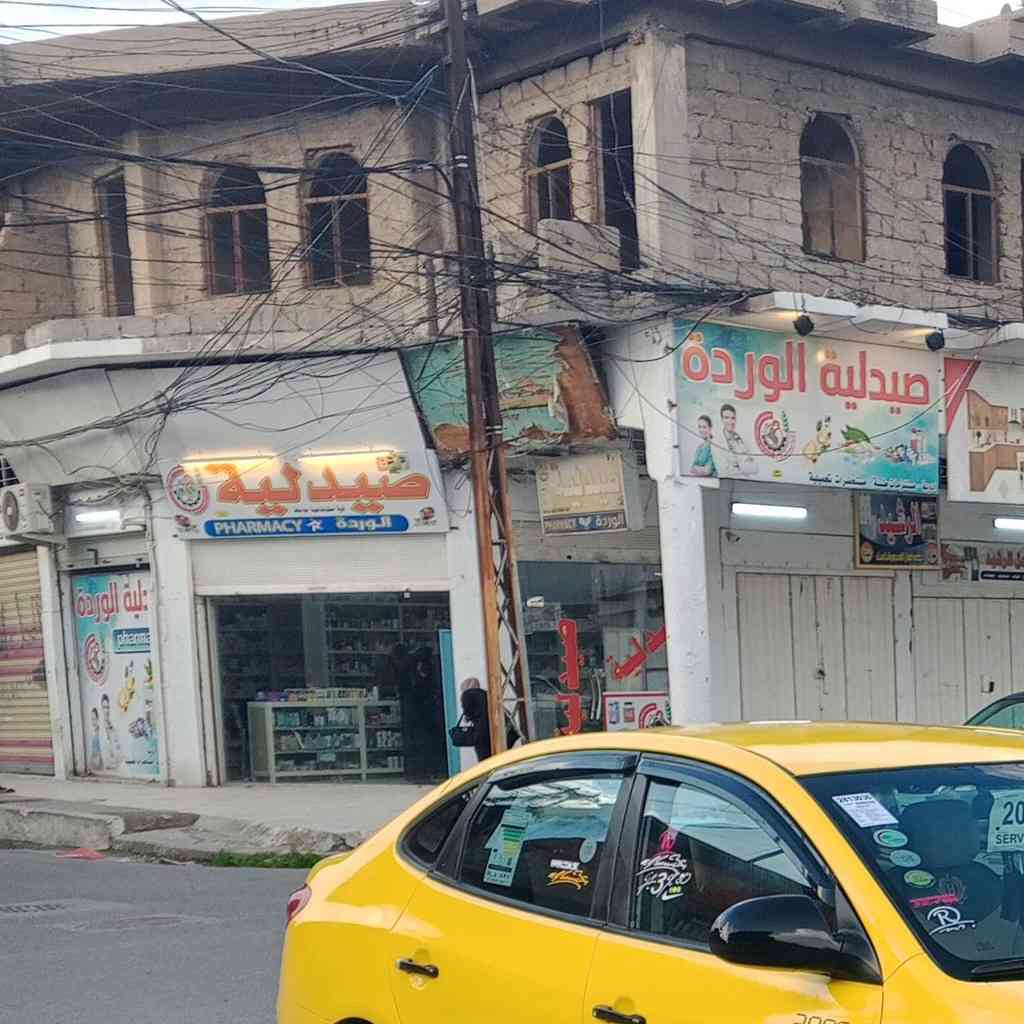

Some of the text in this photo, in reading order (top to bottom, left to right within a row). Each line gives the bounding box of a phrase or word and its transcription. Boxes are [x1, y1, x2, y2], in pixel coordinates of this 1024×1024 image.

[682, 331, 930, 415] صيدلية الوردة
[204, 462, 433, 517] صيدلية
[213, 519, 303, 535] PHARMACY
